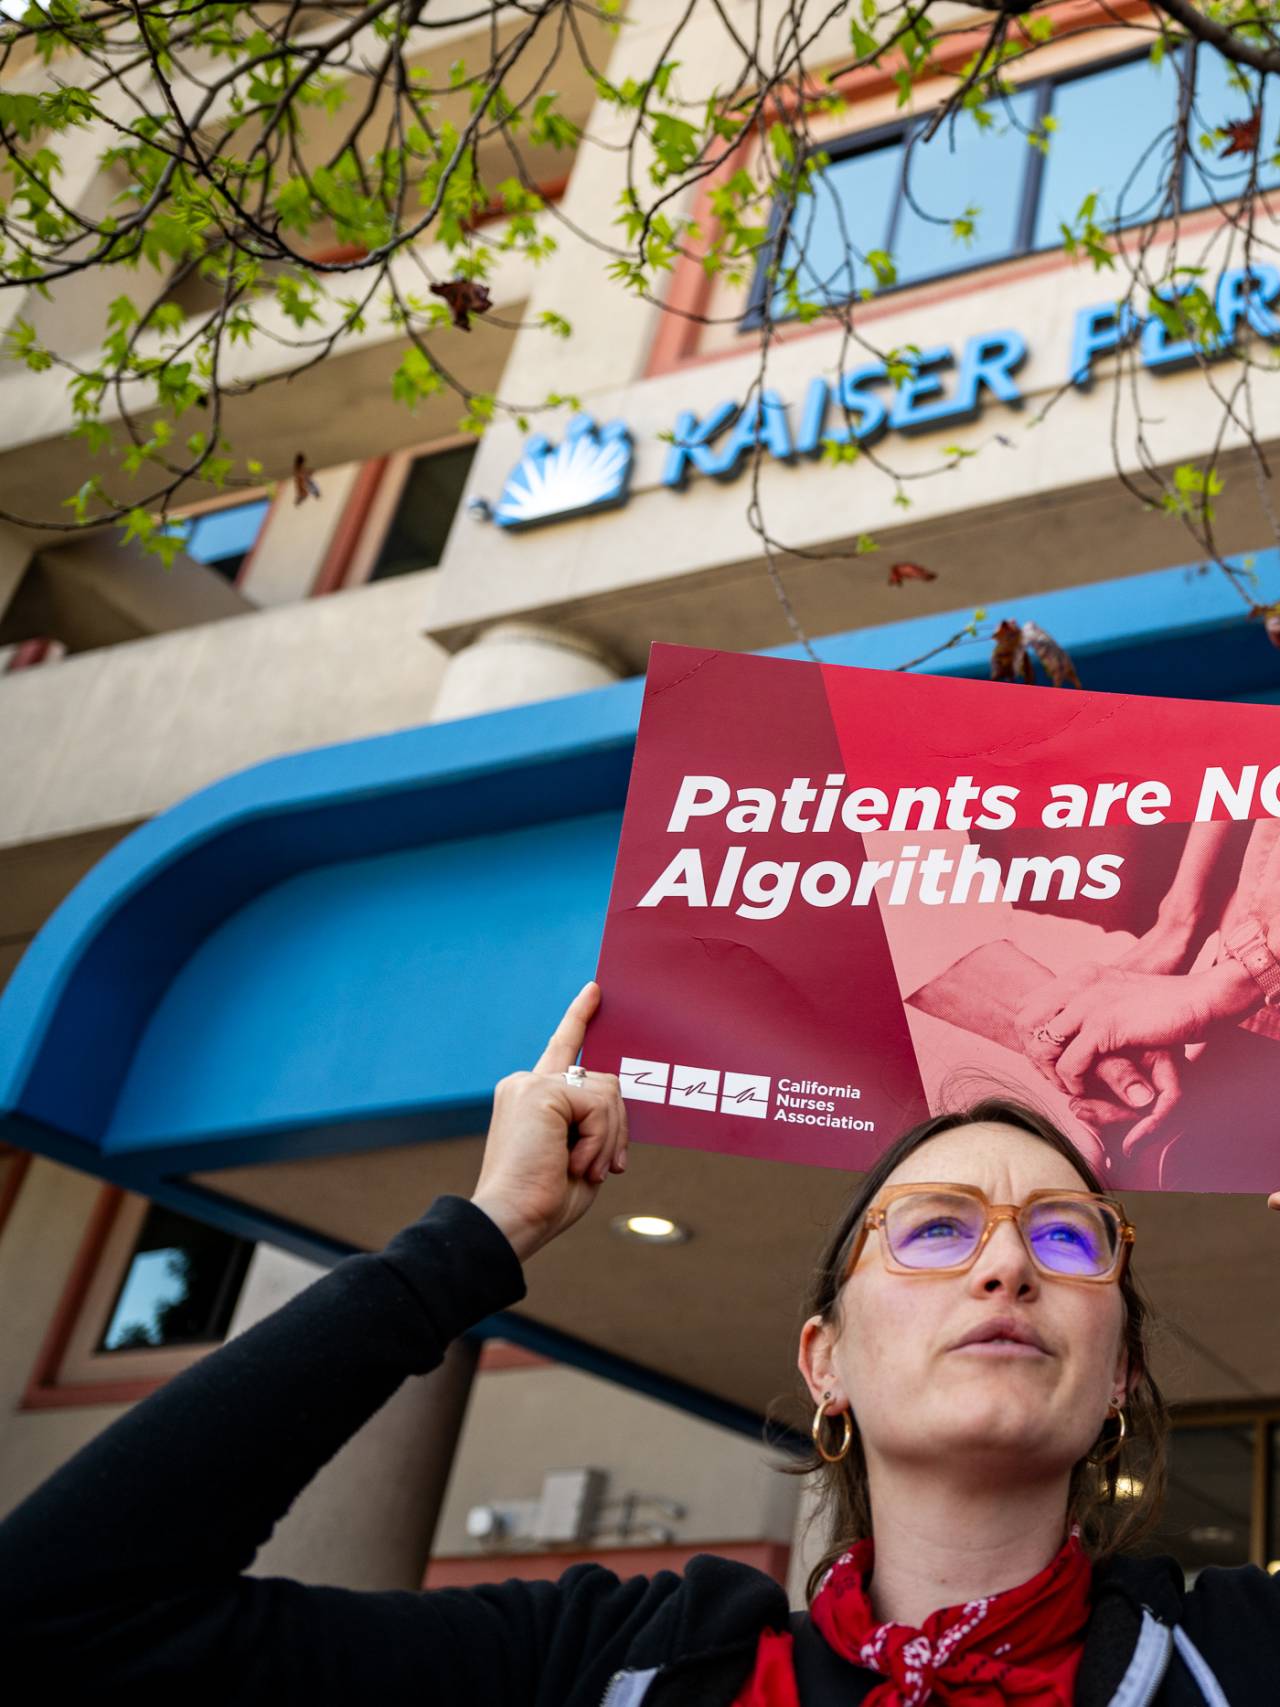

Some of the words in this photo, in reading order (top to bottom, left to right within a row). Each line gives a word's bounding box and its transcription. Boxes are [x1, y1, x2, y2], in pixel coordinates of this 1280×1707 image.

[662, 327, 1028, 488] KAISER
[667, 774, 1020, 833] Patients
[1041, 780, 1171, 829] are
[637, 844, 1125, 920] Algorithms
[776, 1093, 835, 1112] Nurses
[777, 1078, 861, 1099] California
[773, 1108, 875, 1132] Association
